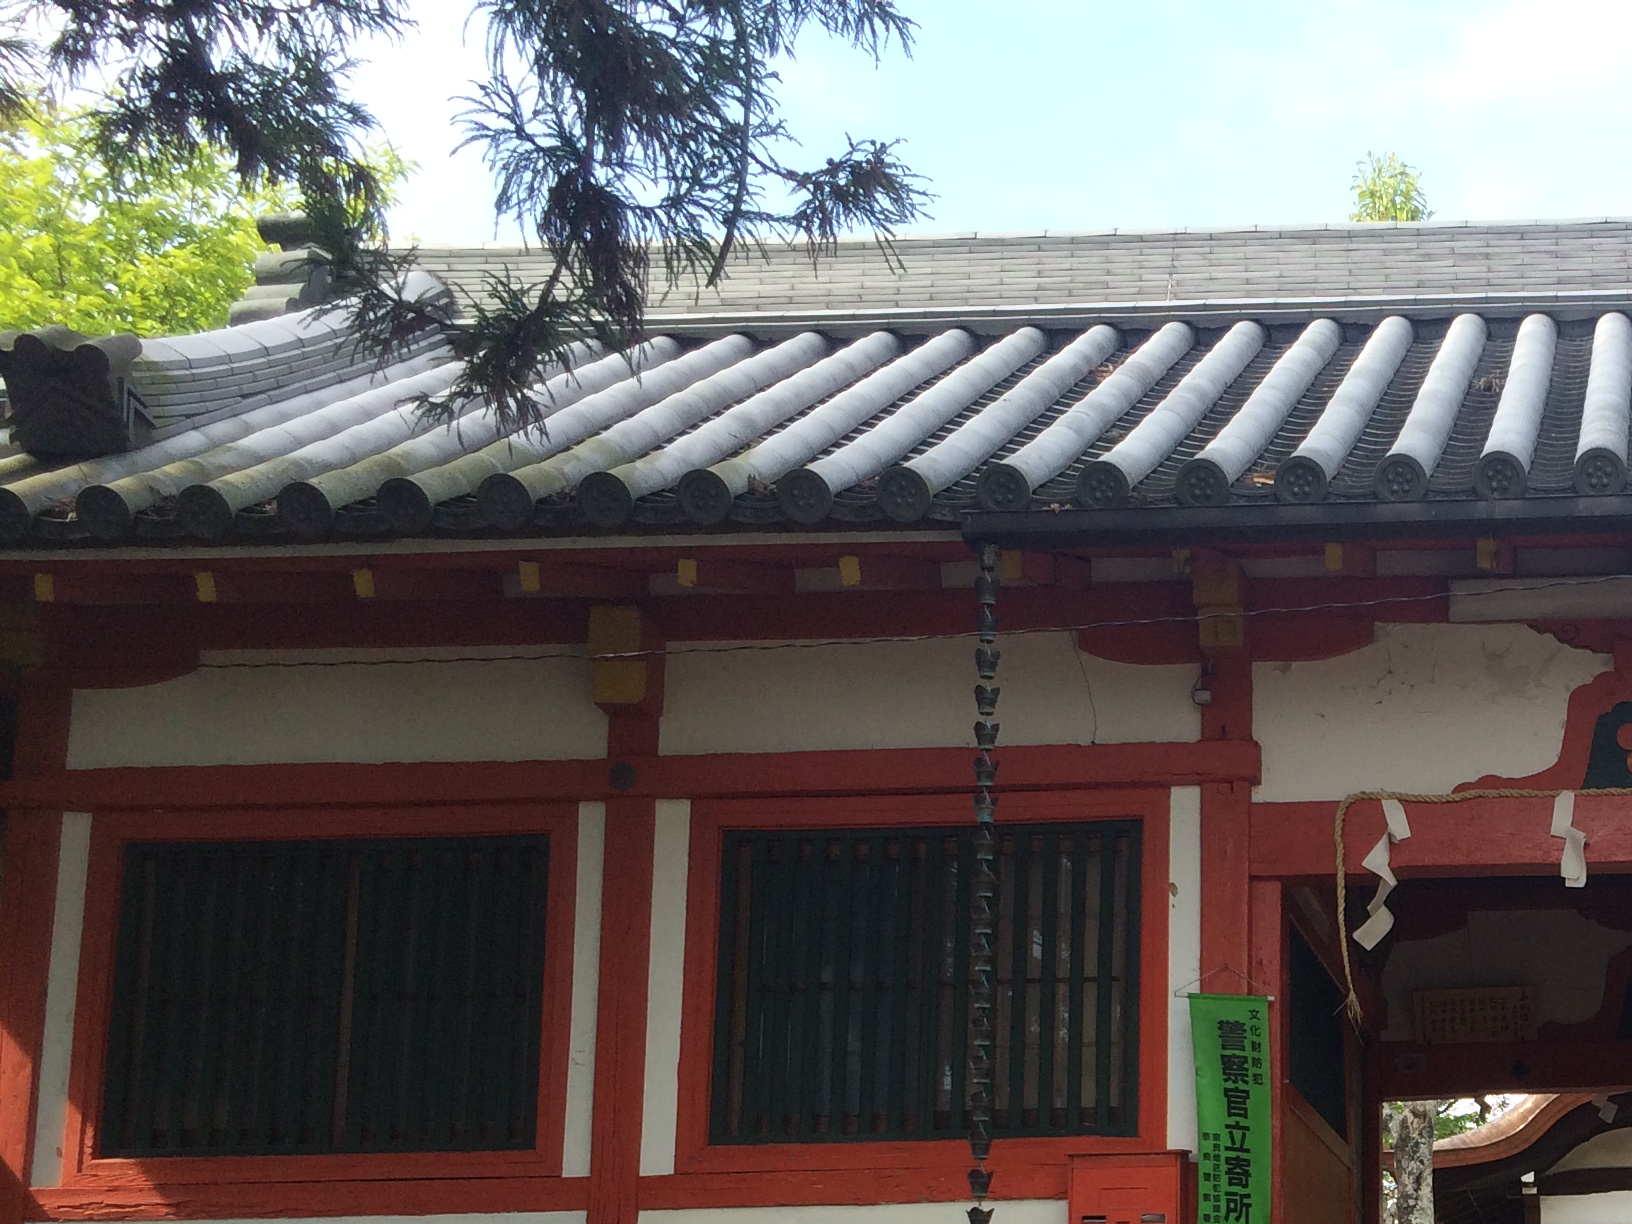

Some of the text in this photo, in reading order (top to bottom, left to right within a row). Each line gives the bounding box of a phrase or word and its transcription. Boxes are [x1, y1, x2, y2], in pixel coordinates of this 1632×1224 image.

[1248, 1008, 1263, 1086] 文化財防犯
[1217, 1020, 1253, 1224] 警察官立寄所
